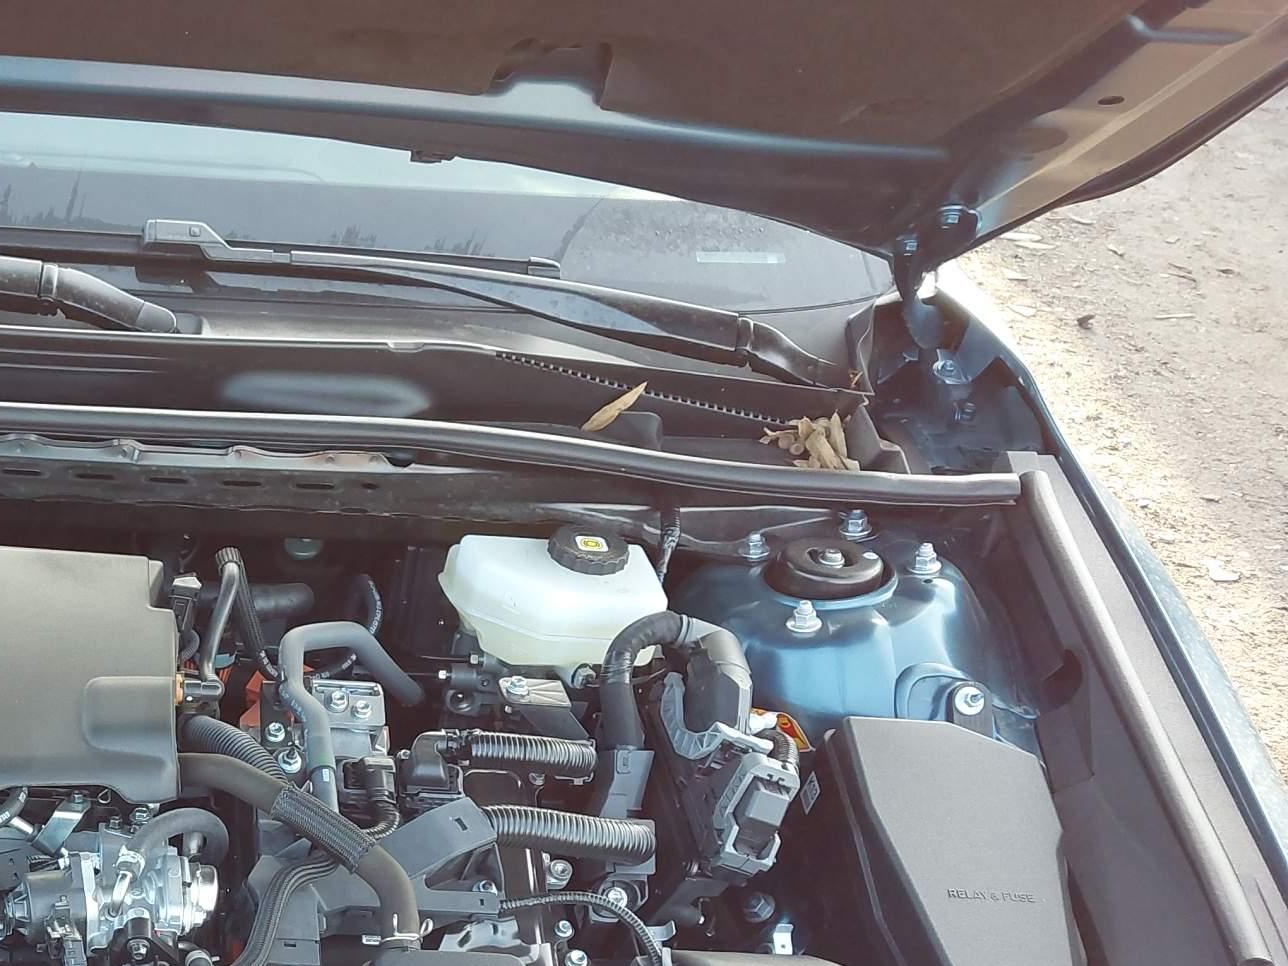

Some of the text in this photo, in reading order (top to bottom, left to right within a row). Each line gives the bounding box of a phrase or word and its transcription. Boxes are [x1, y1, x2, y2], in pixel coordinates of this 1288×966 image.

[947, 888, 1036, 903] RELAY & FUSE
